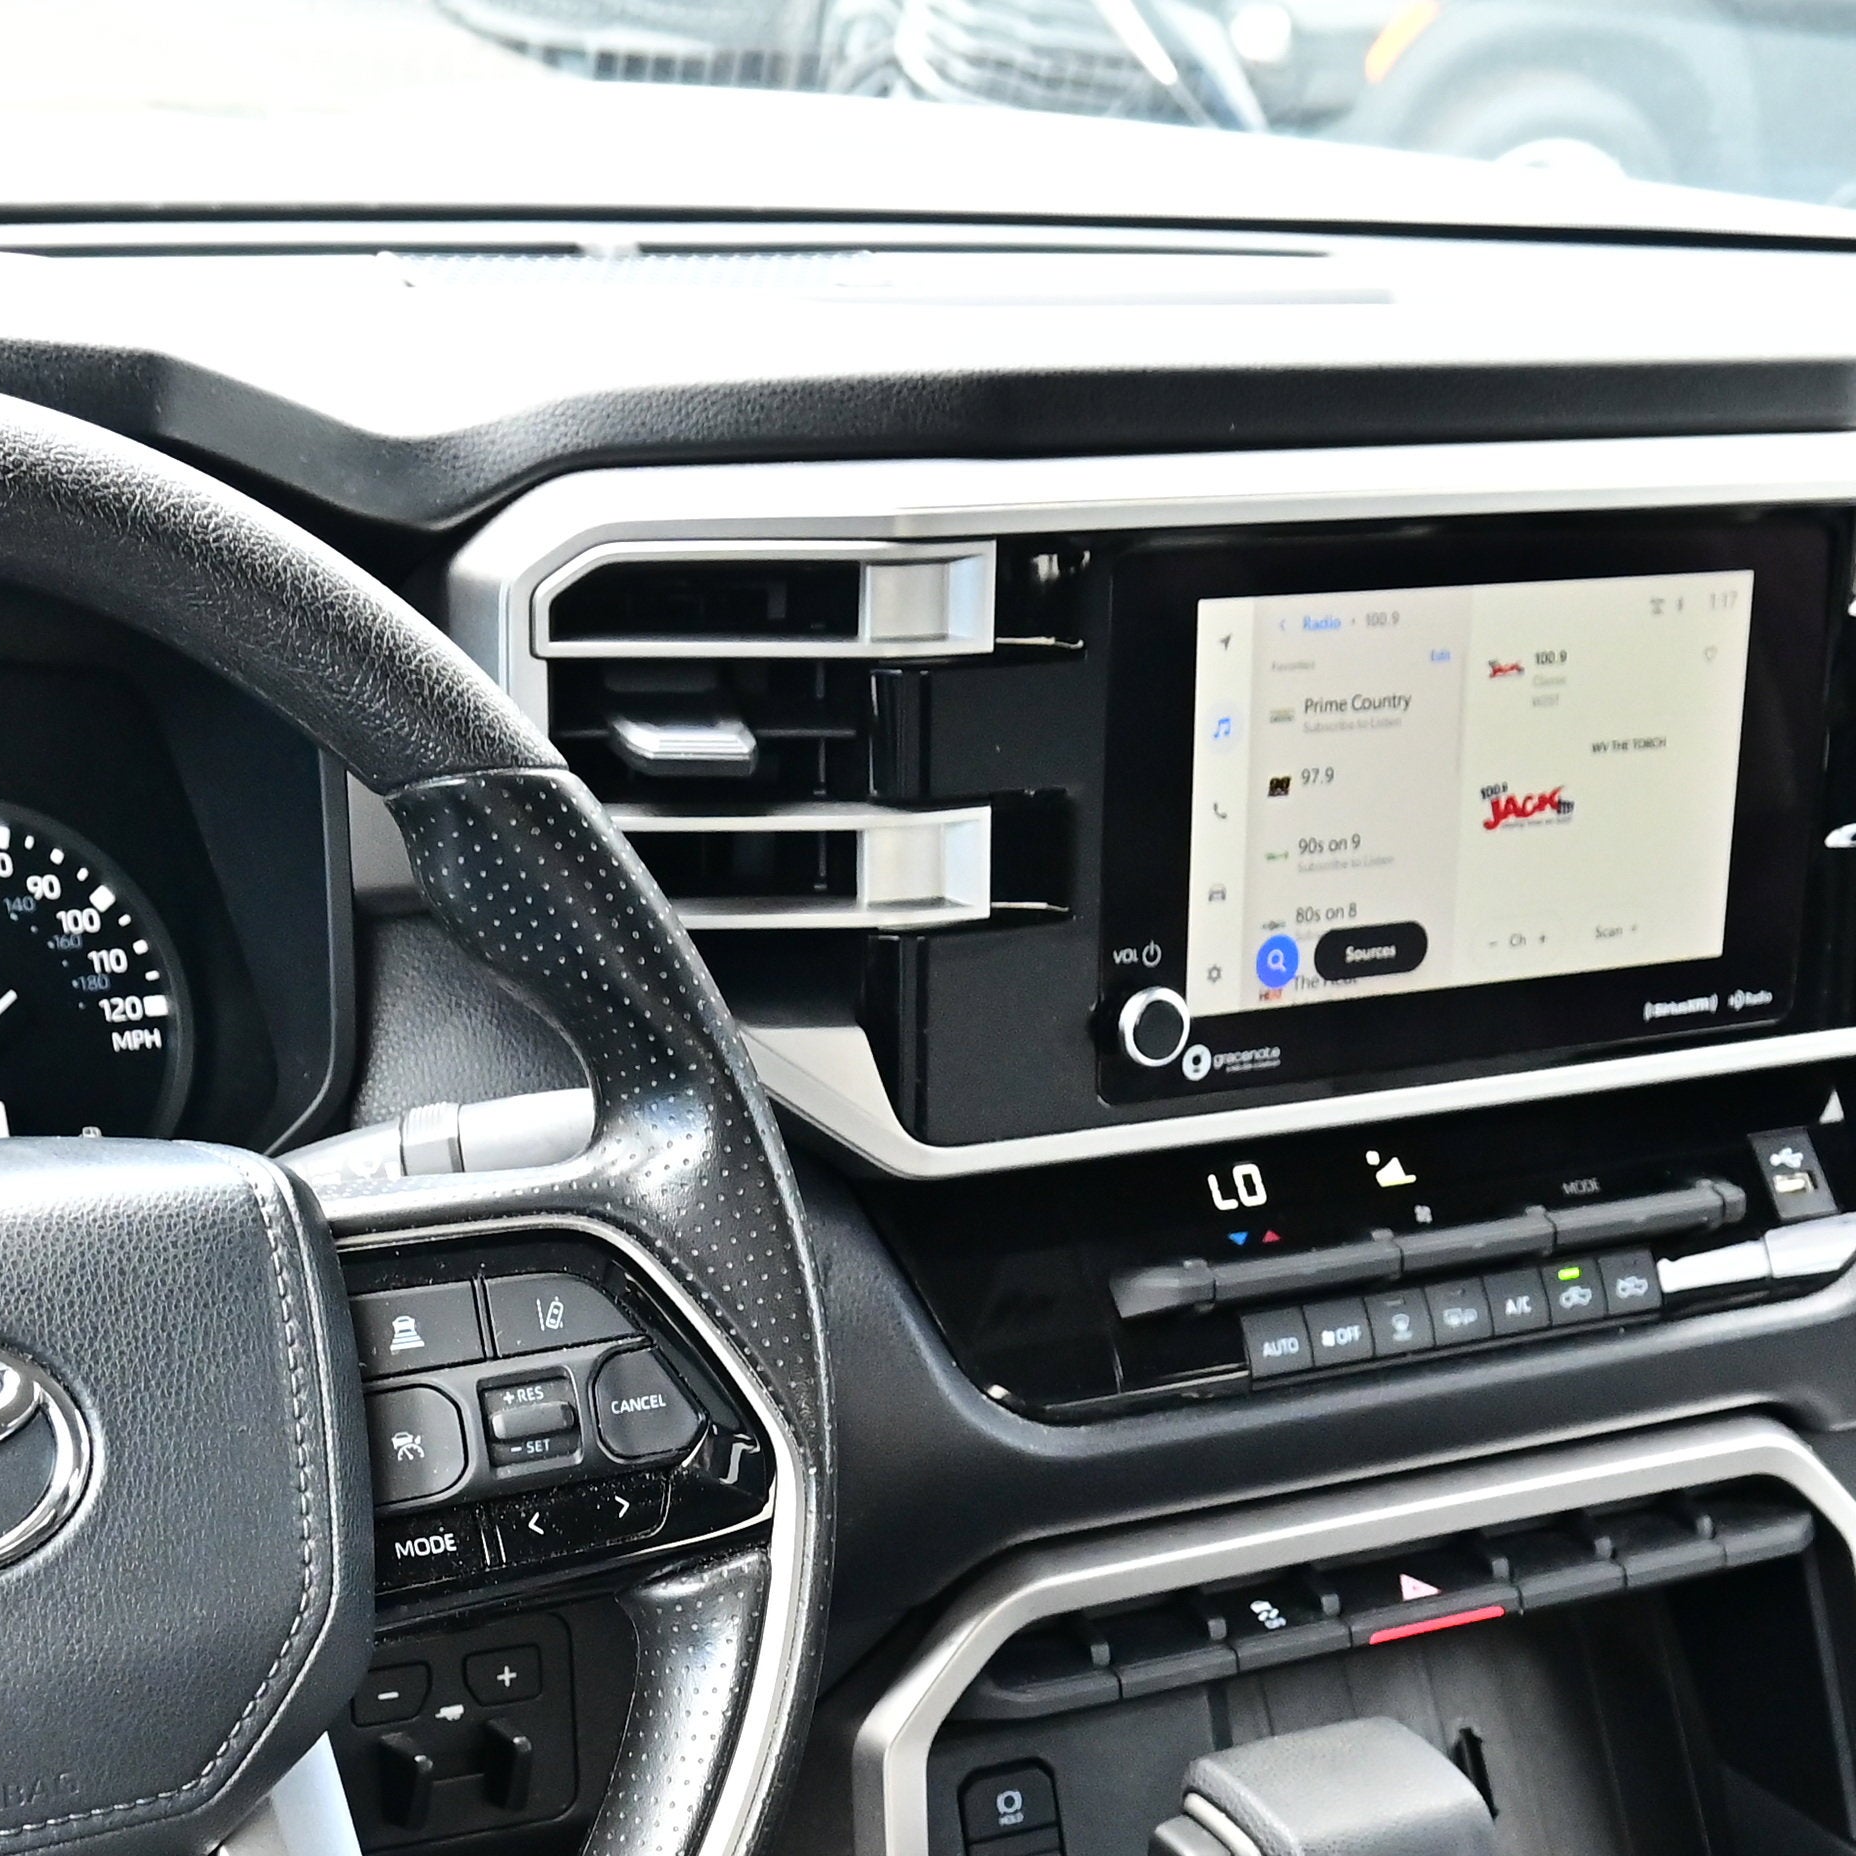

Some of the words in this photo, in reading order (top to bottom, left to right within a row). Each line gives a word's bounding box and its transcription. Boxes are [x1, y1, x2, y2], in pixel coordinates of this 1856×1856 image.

[1303, 616, 1341, 631] Radio
[1535, 650, 1567, 665] 100.9
[1304, 697, 1347, 714] Prime
[1351, 693, 1412, 712] Country
[1301, 767, 1334, 785] 97.9
[1483, 785, 1564, 830] JACK
[1298, 836, 1324, 855] 90s
[1328, 838, 1347, 852] on
[1351, 833, 1361, 850] 9
[26, 874, 61, 900] 90
[3, 896, 36, 912] 140
[1296, 906, 1320, 924] 80s
[1326, 907, 1344, 920] on
[1348, 902, 1357, 918] 8
[55, 908, 101, 935] 100
[1595, 925, 1623, 939] Scan
[54, 934, 83, 949] 160
[1509, 932, 1526, 947] Ch
[87, 948, 128, 974] 110
[1113, 948, 1138, 964] VOL
[1345, 944, 1396, 963] Sources
[77, 974, 111, 990] 180
[98, 996, 143, 1023] 120
[111, 1028, 162, 1053] MPH
[1207, 1163, 1267, 1211] LO
[1562, 1177, 1601, 1195] MODE
[1505, 1295, 1532, 1316] A/C
[1334, 1324, 1361, 1345] OFF
[1262, 1336, 1299, 1358] AUTO
[610, 1394, 666, 1415] CANCEL
[394, 1533, 457, 1560] MODE
